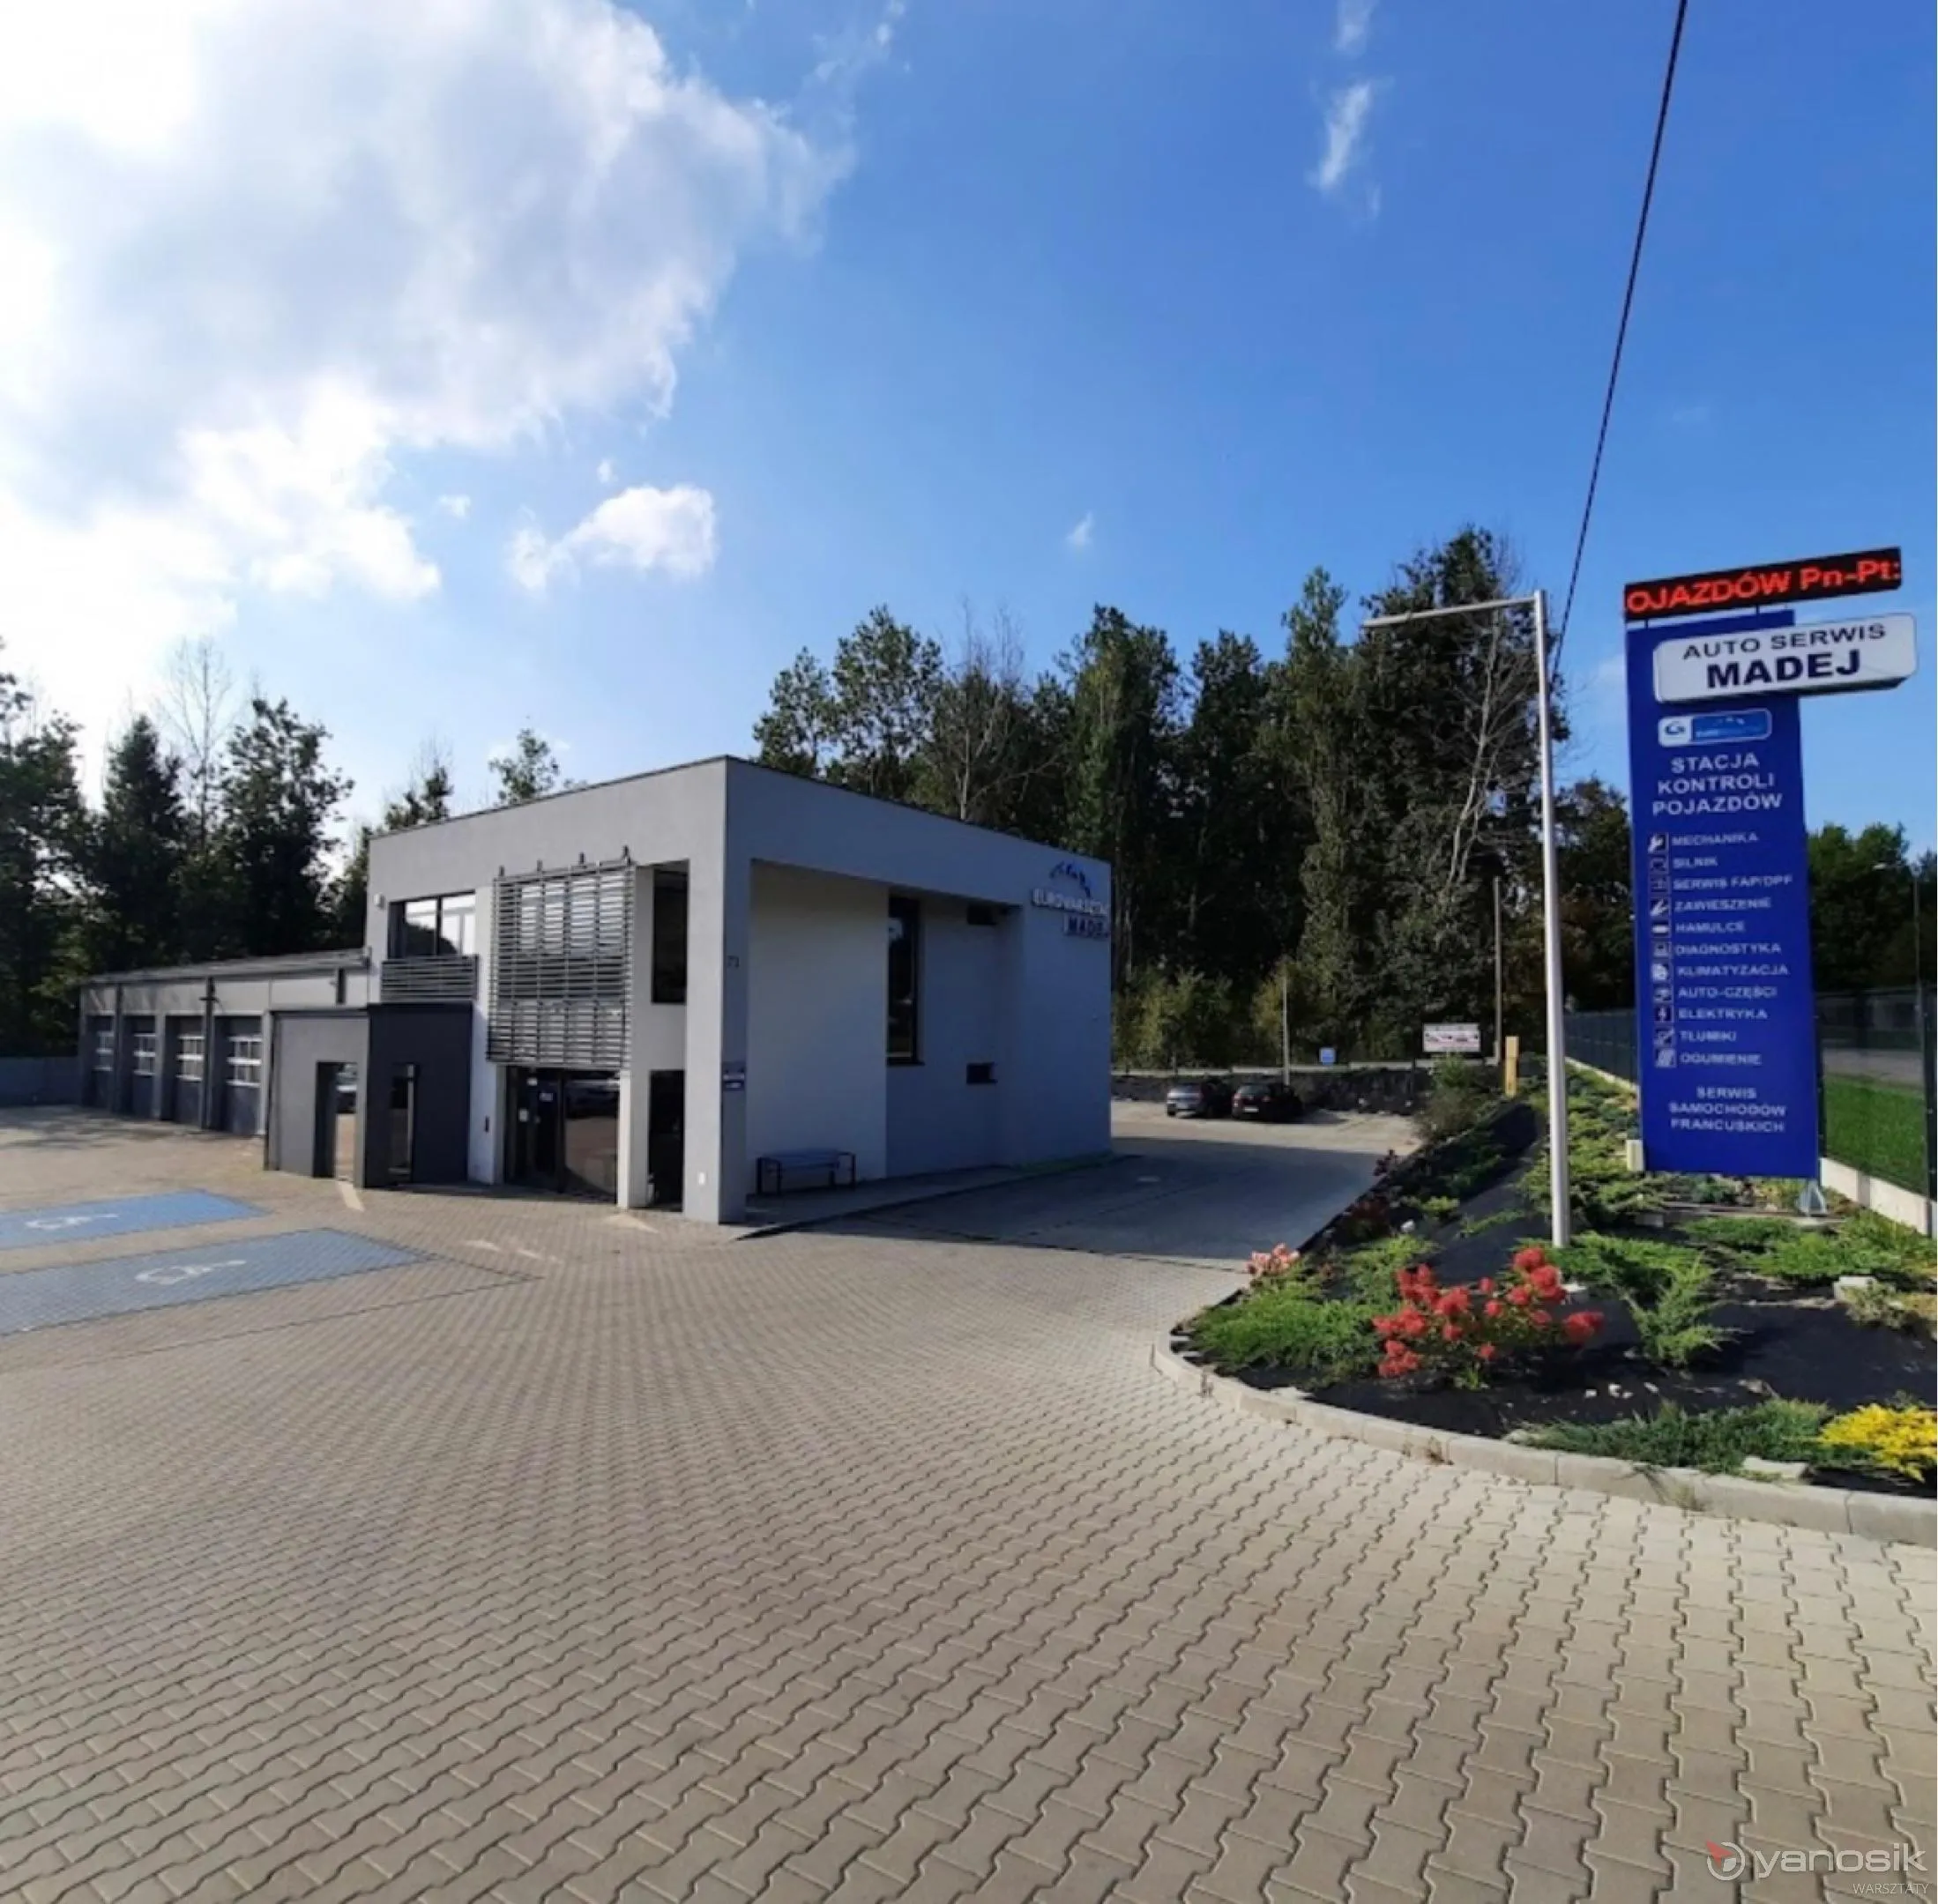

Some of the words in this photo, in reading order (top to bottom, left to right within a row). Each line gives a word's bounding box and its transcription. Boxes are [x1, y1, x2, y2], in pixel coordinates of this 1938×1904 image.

[1626, 570, 1792, 614] OJAZDÓW
[1683, 638, 1761, 660] AUTO
[1770, 622, 1886, 650] SERWIS
[1707, 649, 1860, 689] MADEJ
[1671, 752, 1761, 773] STACJA
[1658, 772, 1775, 795] KONTROLI
[1652, 792, 1783, 817] POJAZDÓW
[1672, 831, 1758, 846] MECHANIKA
[1673, 856, 1718, 869] SILNIK
[1673, 877, 1727, 889] SERWIS
[1675, 897, 1770, 911] ZAWIESZENIE
[1675, 920, 1746, 933] HAMULCE
[1675, 942, 1782, 956] DIAGNOSTYKA
[1678, 964, 1788, 976] KLIMATYZACJA
[1678, 1008, 1769, 1020] ELEKTRYKA
[1696, 1086, 1757, 1099] SERWIS
[1671, 1119, 1785, 1133] FRANCUSKICH
